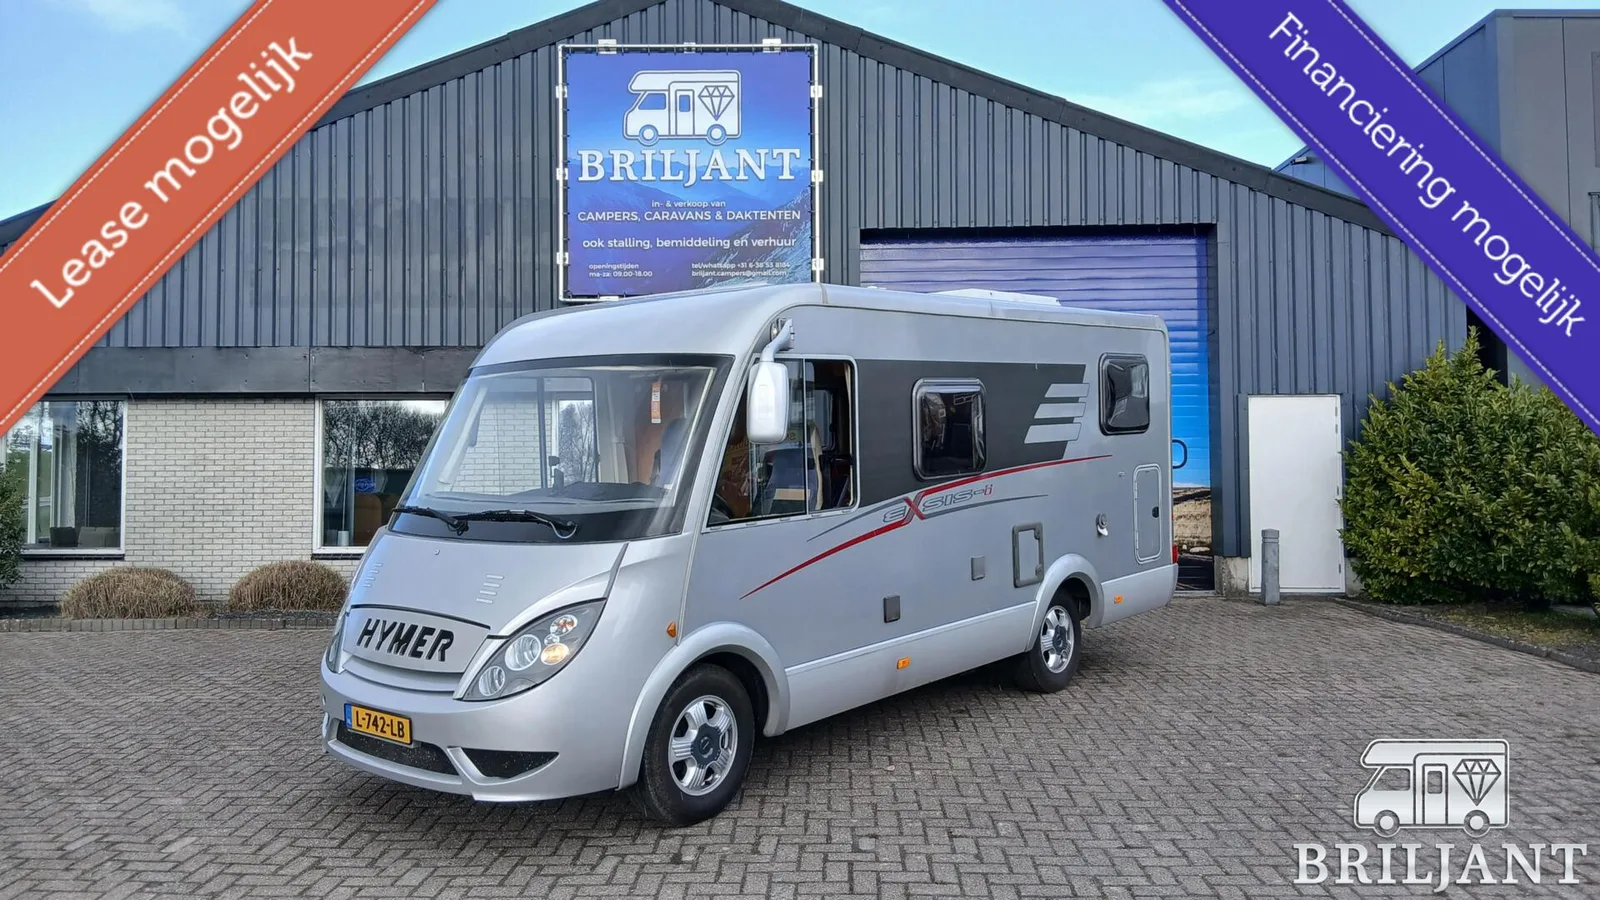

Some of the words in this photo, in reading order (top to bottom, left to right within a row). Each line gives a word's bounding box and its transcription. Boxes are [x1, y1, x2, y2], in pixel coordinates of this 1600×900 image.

[578, 148, 801, 188] BRILJANT
[673, 200, 708, 209] verkoop
[710, 200, 727, 208] van
[577, 211, 641, 222] CAMPERS,
[644, 210, 712, 221] CARAVANS
[714, 210, 723, 221] &
[726, 210, 801, 221] DAKTENTEN
[582, 238, 605, 248] ook
[607, 237, 653, 250] stalling,
[656, 237, 731, 249] bemiddeling
[733, 238, 748, 247] en
[750, 237, 797, 247] verhuur
[588, 262, 640, 271] openingstijden
[612, 270, 653, 278] 09.00-18.00
[356, 617, 455, 663] HYMER
[355, 710, 405, 738] L-742-LB
